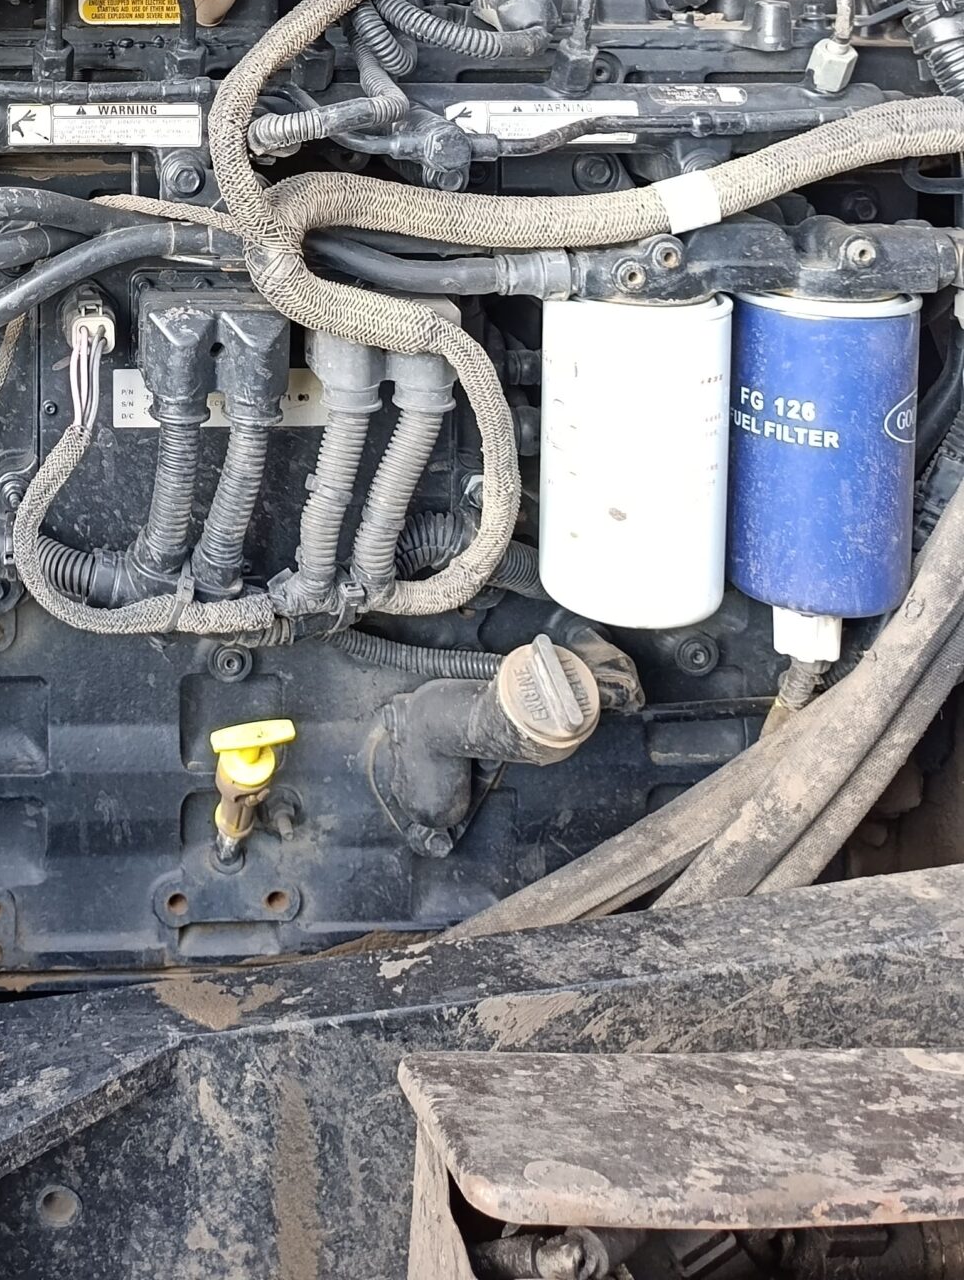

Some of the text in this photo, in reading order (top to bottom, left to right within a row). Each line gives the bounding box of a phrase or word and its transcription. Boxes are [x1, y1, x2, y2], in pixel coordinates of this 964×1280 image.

[98, 104, 158, 116] WARNING
[533, 102, 594, 113] WARNING
[740, 386, 816, 422] FG 126
[764, 421, 840, 449] FILTER
[514, 663, 549, 722] ENGINE
